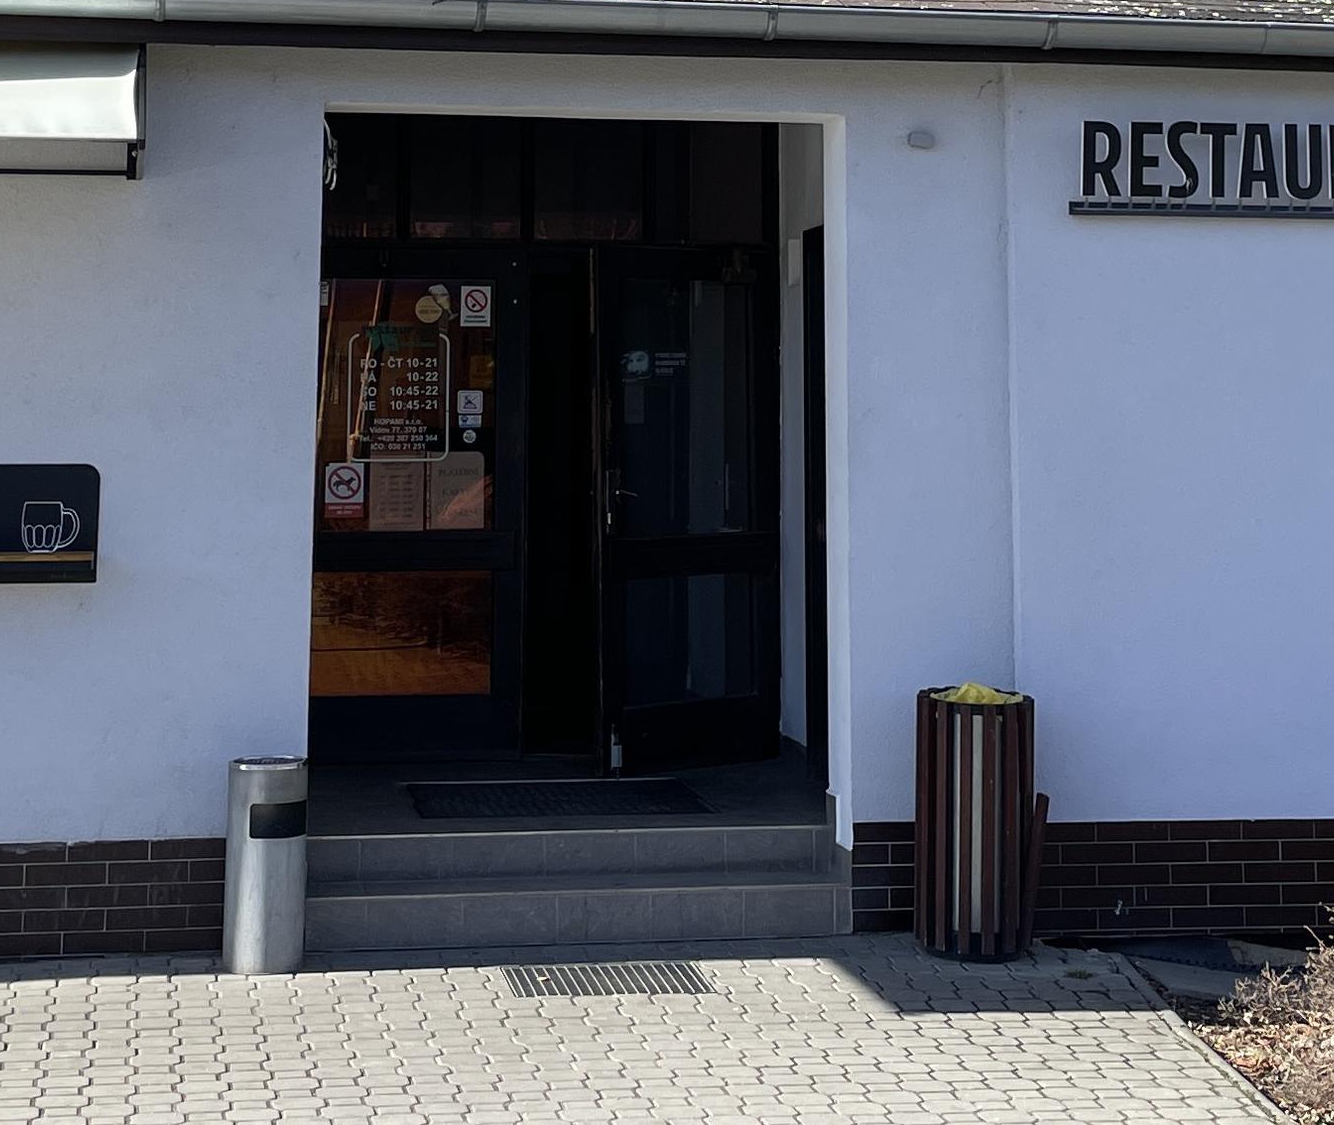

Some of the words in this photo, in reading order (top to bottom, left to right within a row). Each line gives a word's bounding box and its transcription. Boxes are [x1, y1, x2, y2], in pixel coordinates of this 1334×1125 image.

[387, 355, 404, 369] ČT
[407, 357, 438, 368] 10-21
[407, 371, 439, 382] 10-22
[390, 385, 439, 396] 10:45-22
[390, 399, 438, 410] 10:45-21
